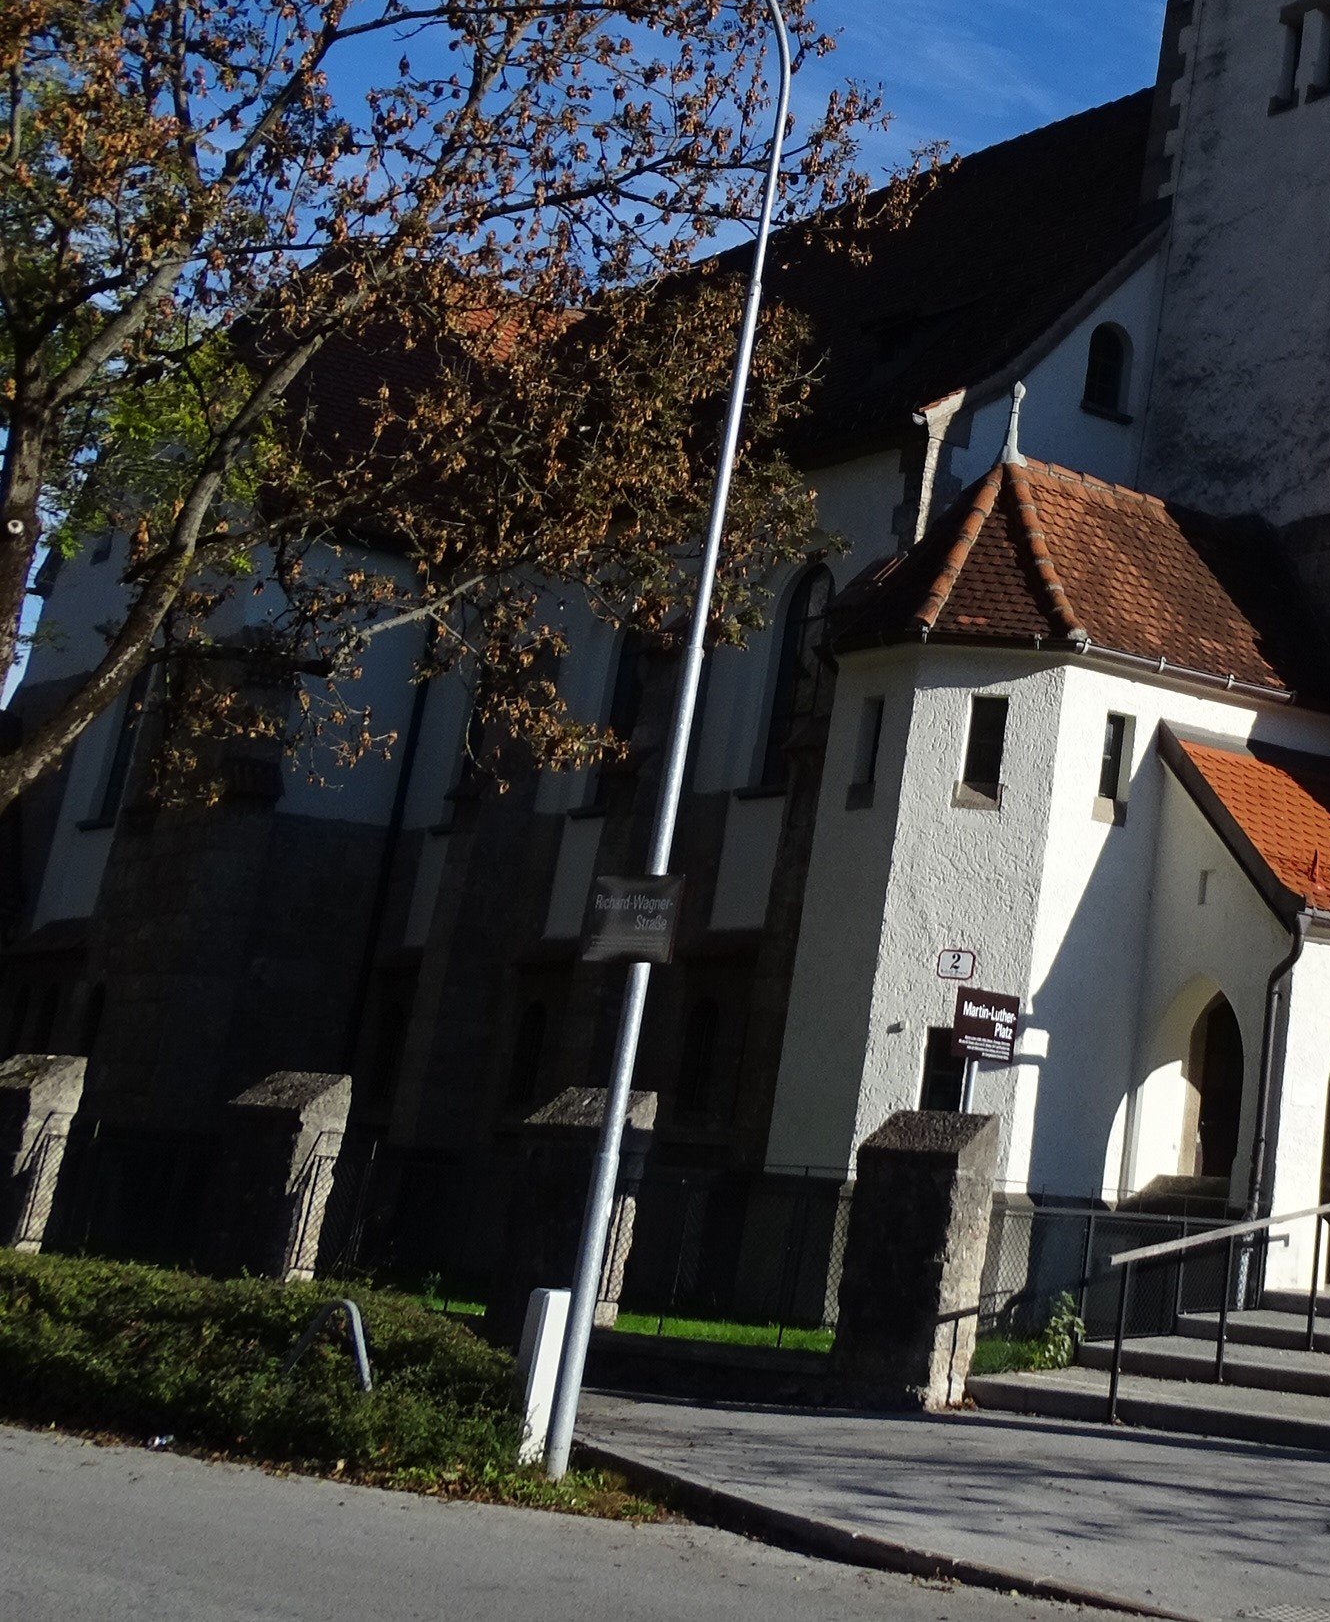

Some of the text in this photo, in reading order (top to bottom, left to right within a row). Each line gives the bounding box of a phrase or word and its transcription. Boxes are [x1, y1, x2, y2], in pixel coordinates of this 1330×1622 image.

[595, 894, 673, 913] Richard-Wagner-
[634, 914, 668, 930] Straße
[950, 953, 961, 970] 2
[963, 1000, 1017, 1024] Martin-Luther-
[994, 1022, 1013, 1039] Platz
